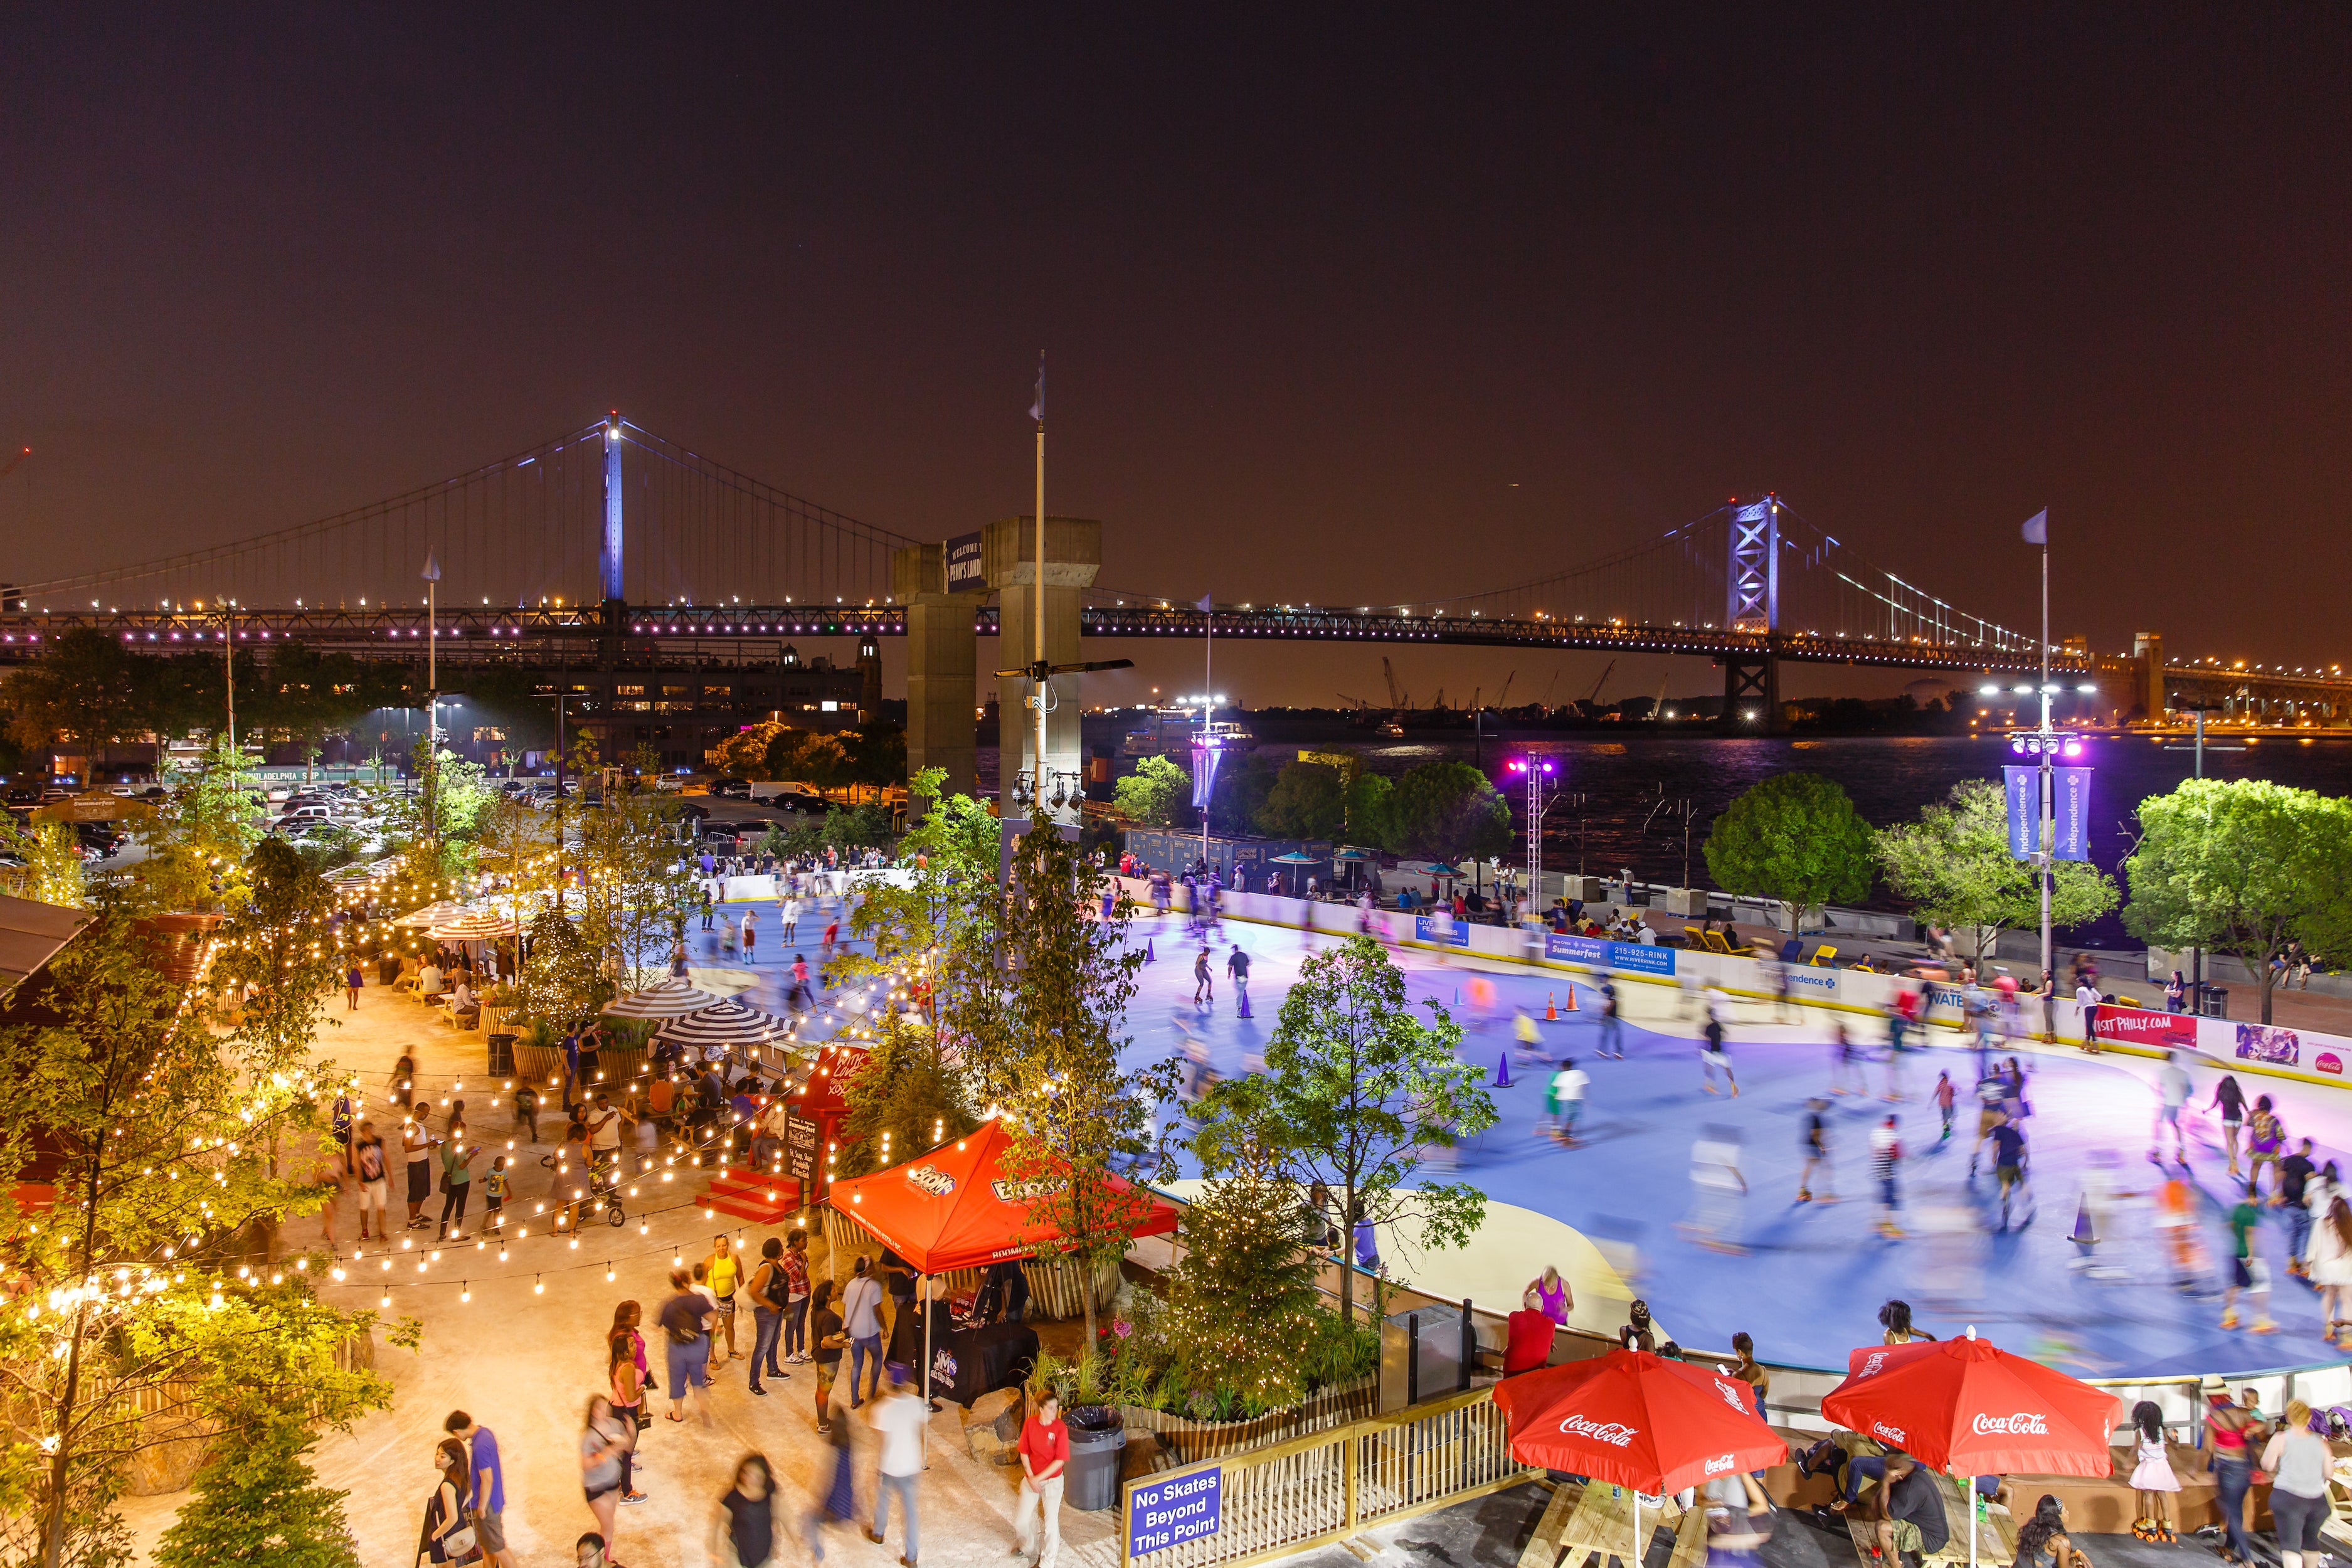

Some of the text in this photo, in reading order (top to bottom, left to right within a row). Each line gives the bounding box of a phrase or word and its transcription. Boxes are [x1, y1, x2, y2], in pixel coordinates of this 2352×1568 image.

[952, 543, 978, 561] WELCOME
[950, 561, 967, 582] PENN'S
[2018, 787, 2030, 853] Independence
[2068, 787, 2079, 853] Independence
[1552, 945, 1601, 959] Summerfest
[1614, 946, 1668, 960] 215-925-RINK
[1614, 955, 1668, 967] WWW.RIVERRINK.COM
[788, 1121, 815, 1134] Summerfest
[908, 1164, 956, 1197] BOOM
[1858, 1352, 1889, 1379] Coca-Cola
[1559, 1414, 1638, 1447] Coca-Cola
[1873, 1421, 1905, 1443] Coca-Cola
[1972, 1412, 2047, 1435] Coca-Cola
[1704, 1453, 1735, 1475] Coca-Cola
[1136, 1476, 1217, 1509] No Skates
[1146, 1496, 1206, 1528] Beyond
[1135, 1516, 1216, 1551] This Point
